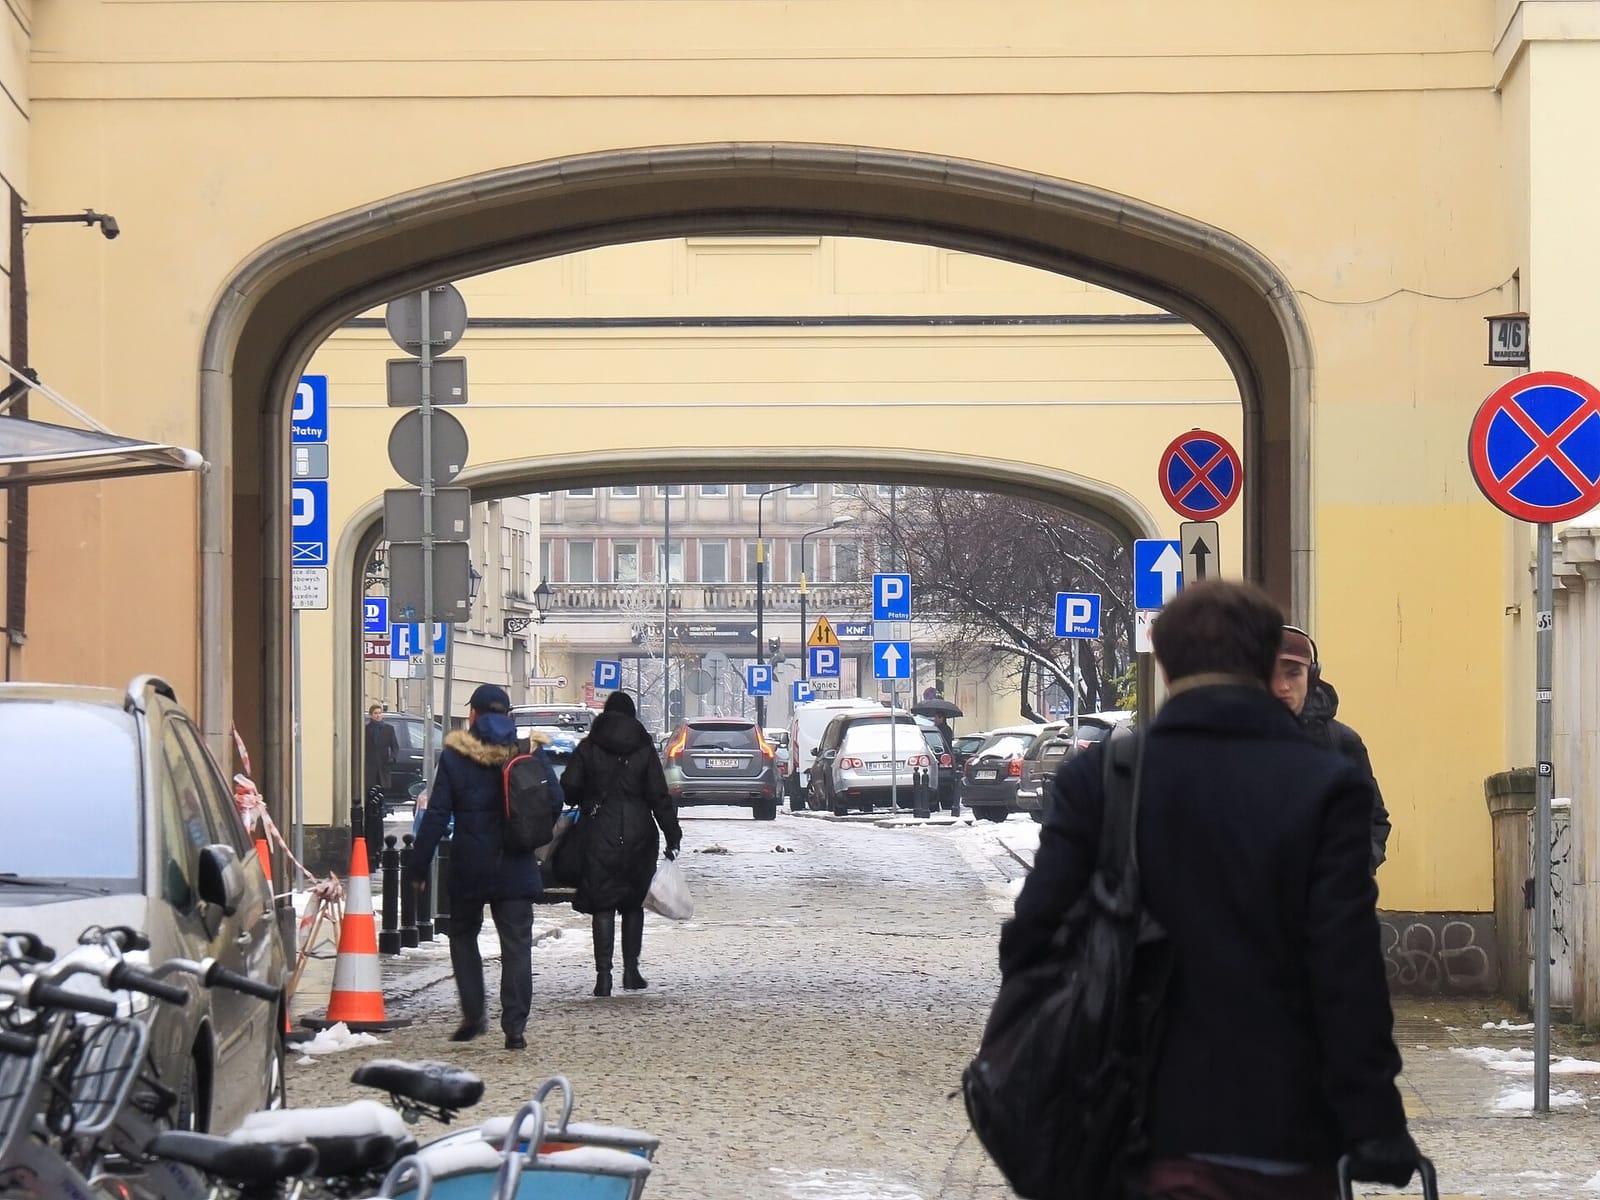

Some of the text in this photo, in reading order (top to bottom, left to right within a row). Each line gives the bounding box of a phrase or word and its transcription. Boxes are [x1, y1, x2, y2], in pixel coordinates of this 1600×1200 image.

[1498, 322, 1521, 350] 4/6
[882, 578, 903, 607] P
[1065, 598, 1091, 632] P
[846, 626, 866, 634] KNF
[817, 650, 834, 673] P
[600, 664, 616, 685] P
[753, 668, 767, 687] P
